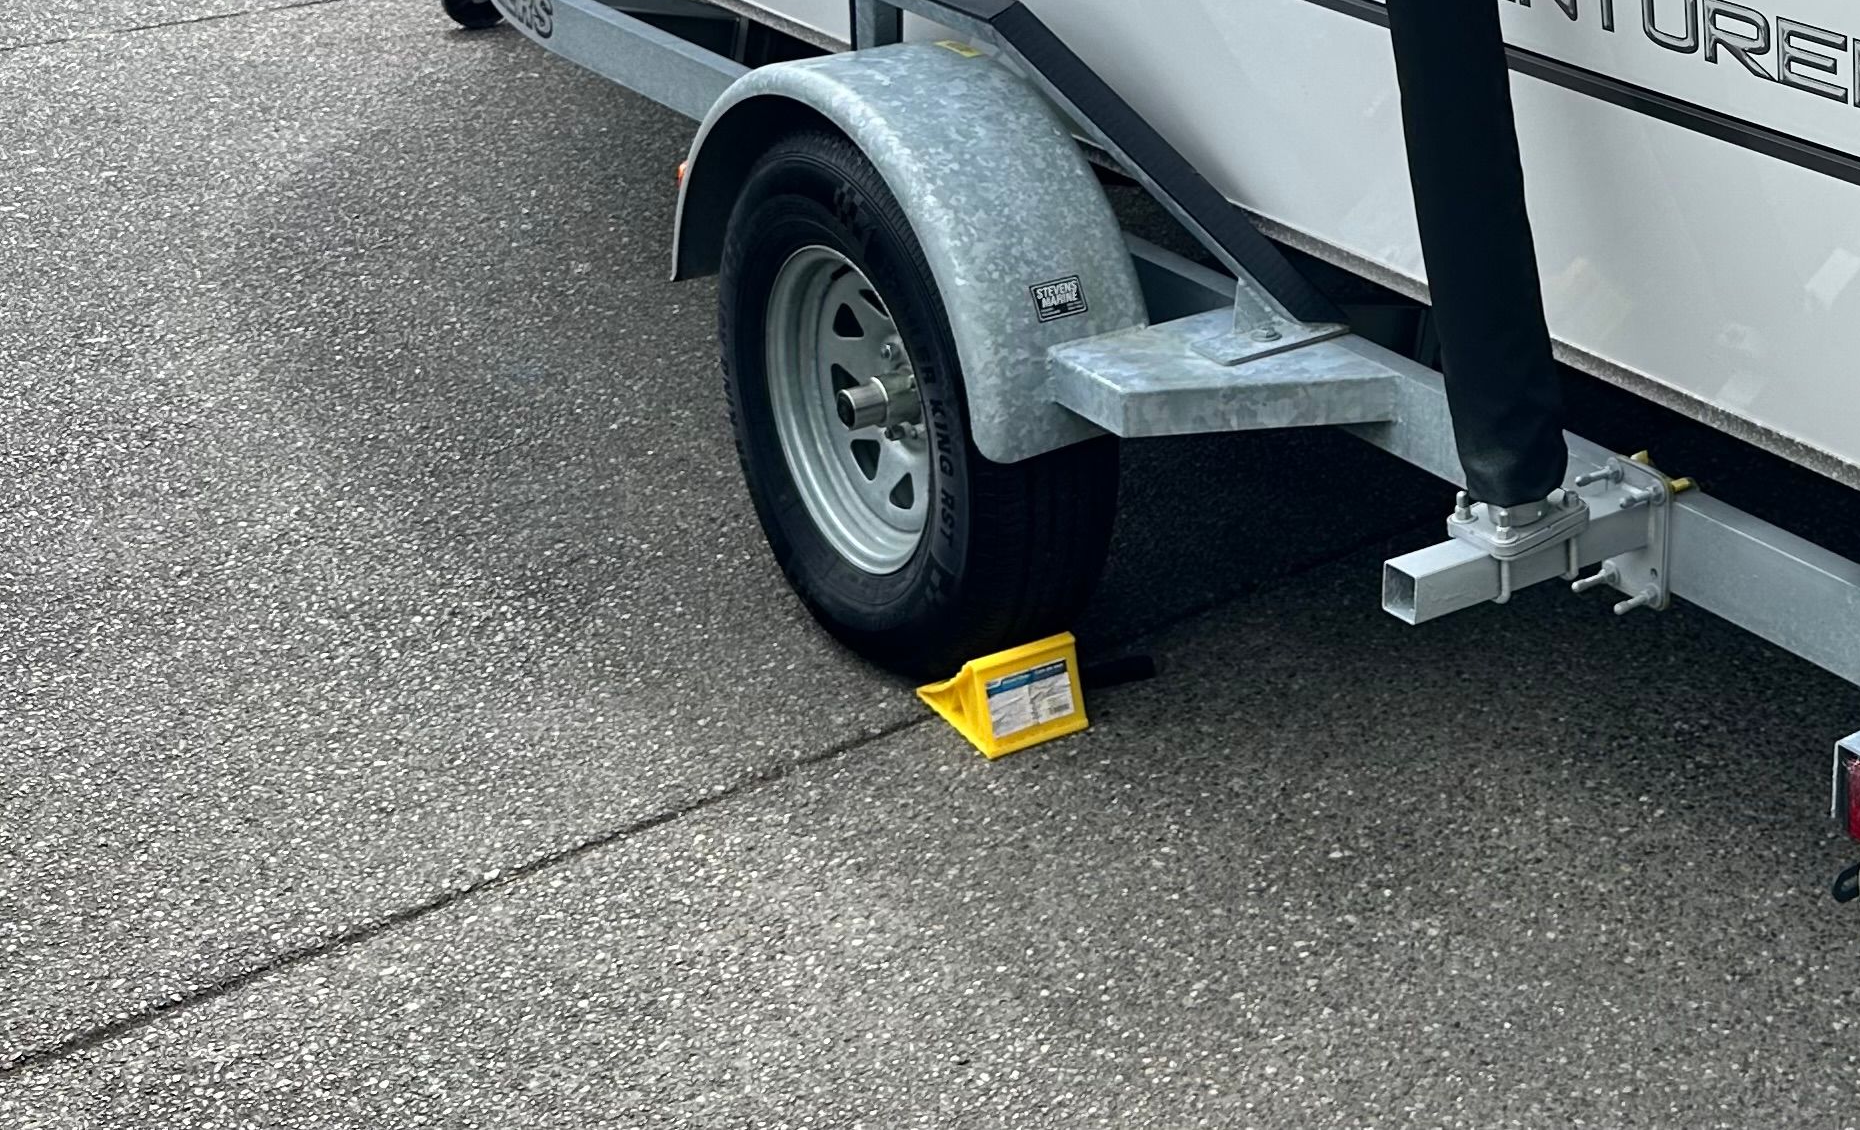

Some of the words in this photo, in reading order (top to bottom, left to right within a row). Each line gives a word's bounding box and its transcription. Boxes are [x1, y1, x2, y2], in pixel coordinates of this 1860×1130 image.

[1036, 279, 1078, 300] STEVENS
[1041, 291, 1078, 309] MARINE
[929, 398, 955, 478] KING
[940, 486, 957, 548] RST
